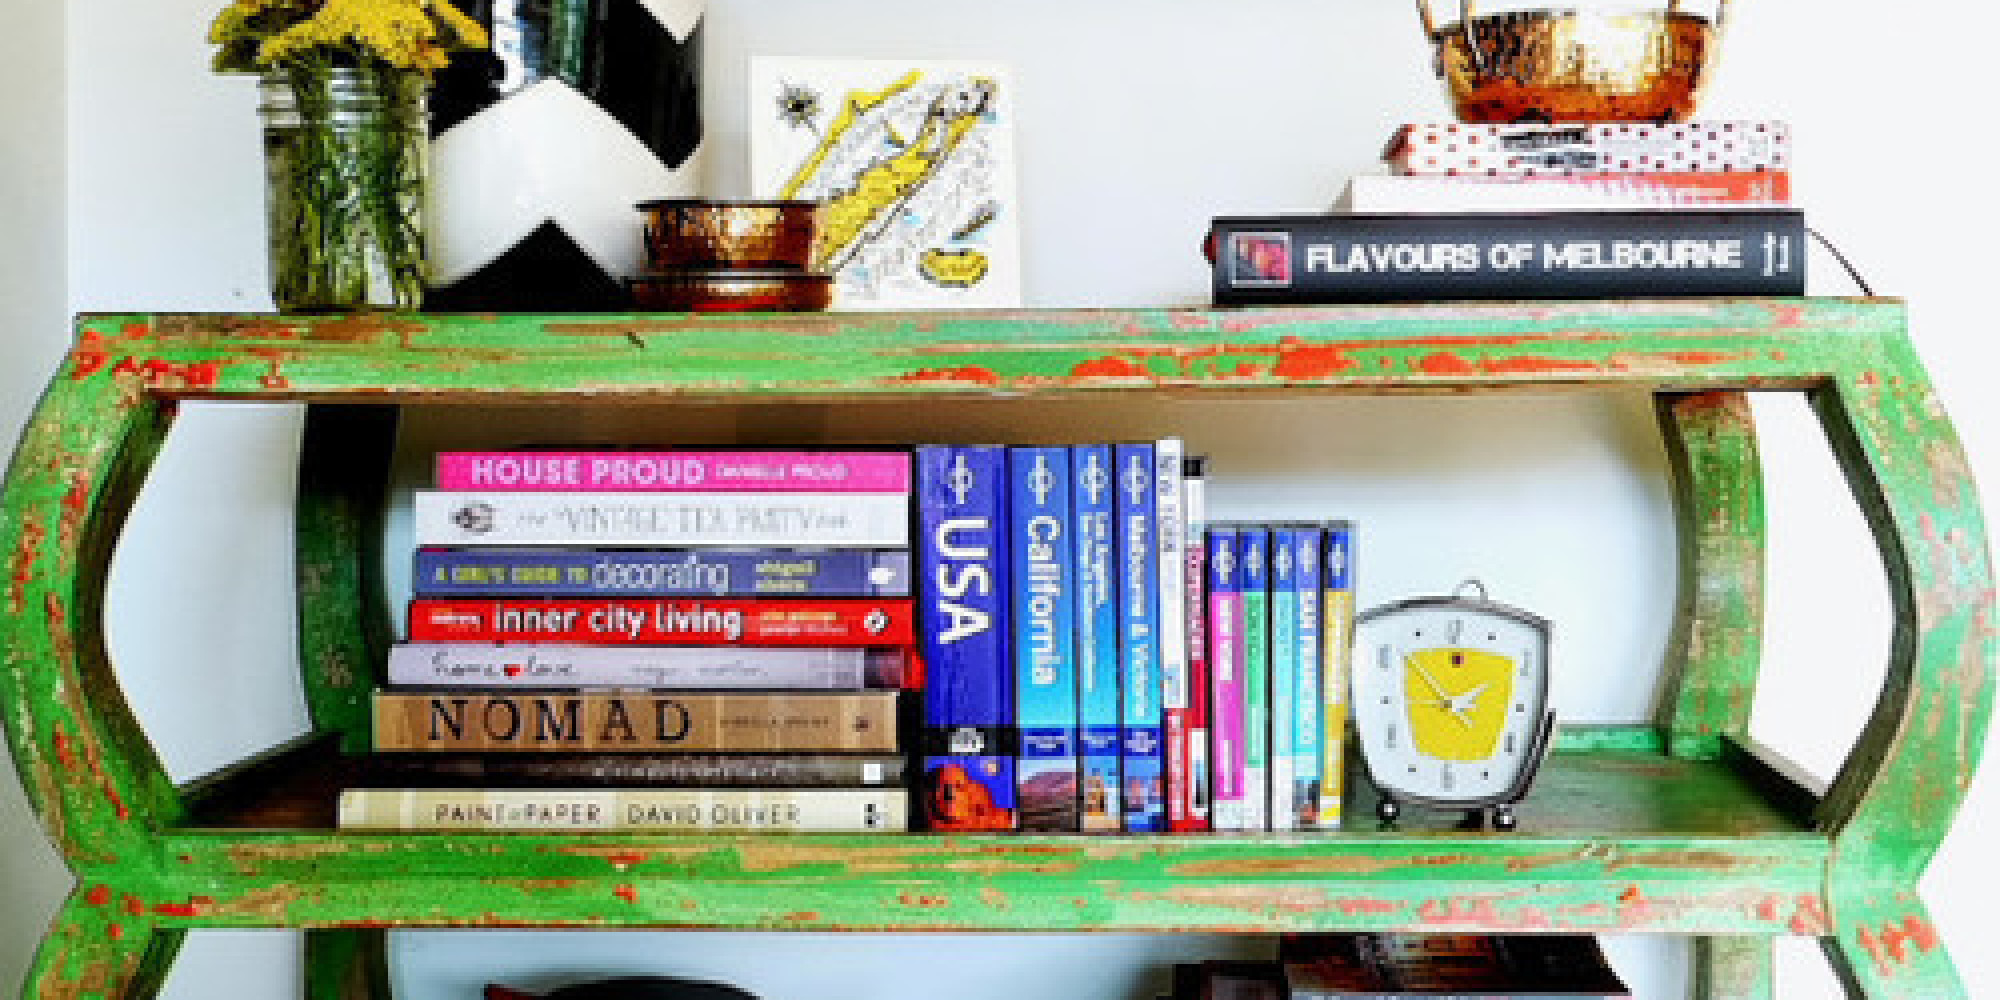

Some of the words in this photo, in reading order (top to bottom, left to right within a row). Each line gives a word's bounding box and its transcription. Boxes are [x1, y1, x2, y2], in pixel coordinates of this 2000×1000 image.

[1306, 243, 1480, 273] FLAVOURS
[1491, 241, 1536, 271] OF
[1543, 239, 1742, 270] MELBOURNE
[471, 459, 579, 485] HOUSE
[591, 459, 707, 485] PROUD
[591, 554, 730, 596] decorating
[936, 517, 993, 645] USA
[1027, 514, 1062, 686] California
[494, 603, 579, 634] inner
[588, 603, 647, 641] city
[655, 603, 746, 641] living
[427, 698, 694, 743] NOMAD
[433, 803, 509, 824] PAINT
[523, 803, 602, 824] PAPER
[627, 803, 701, 825] DAVID
[710, 803, 801, 825] OLIVER
